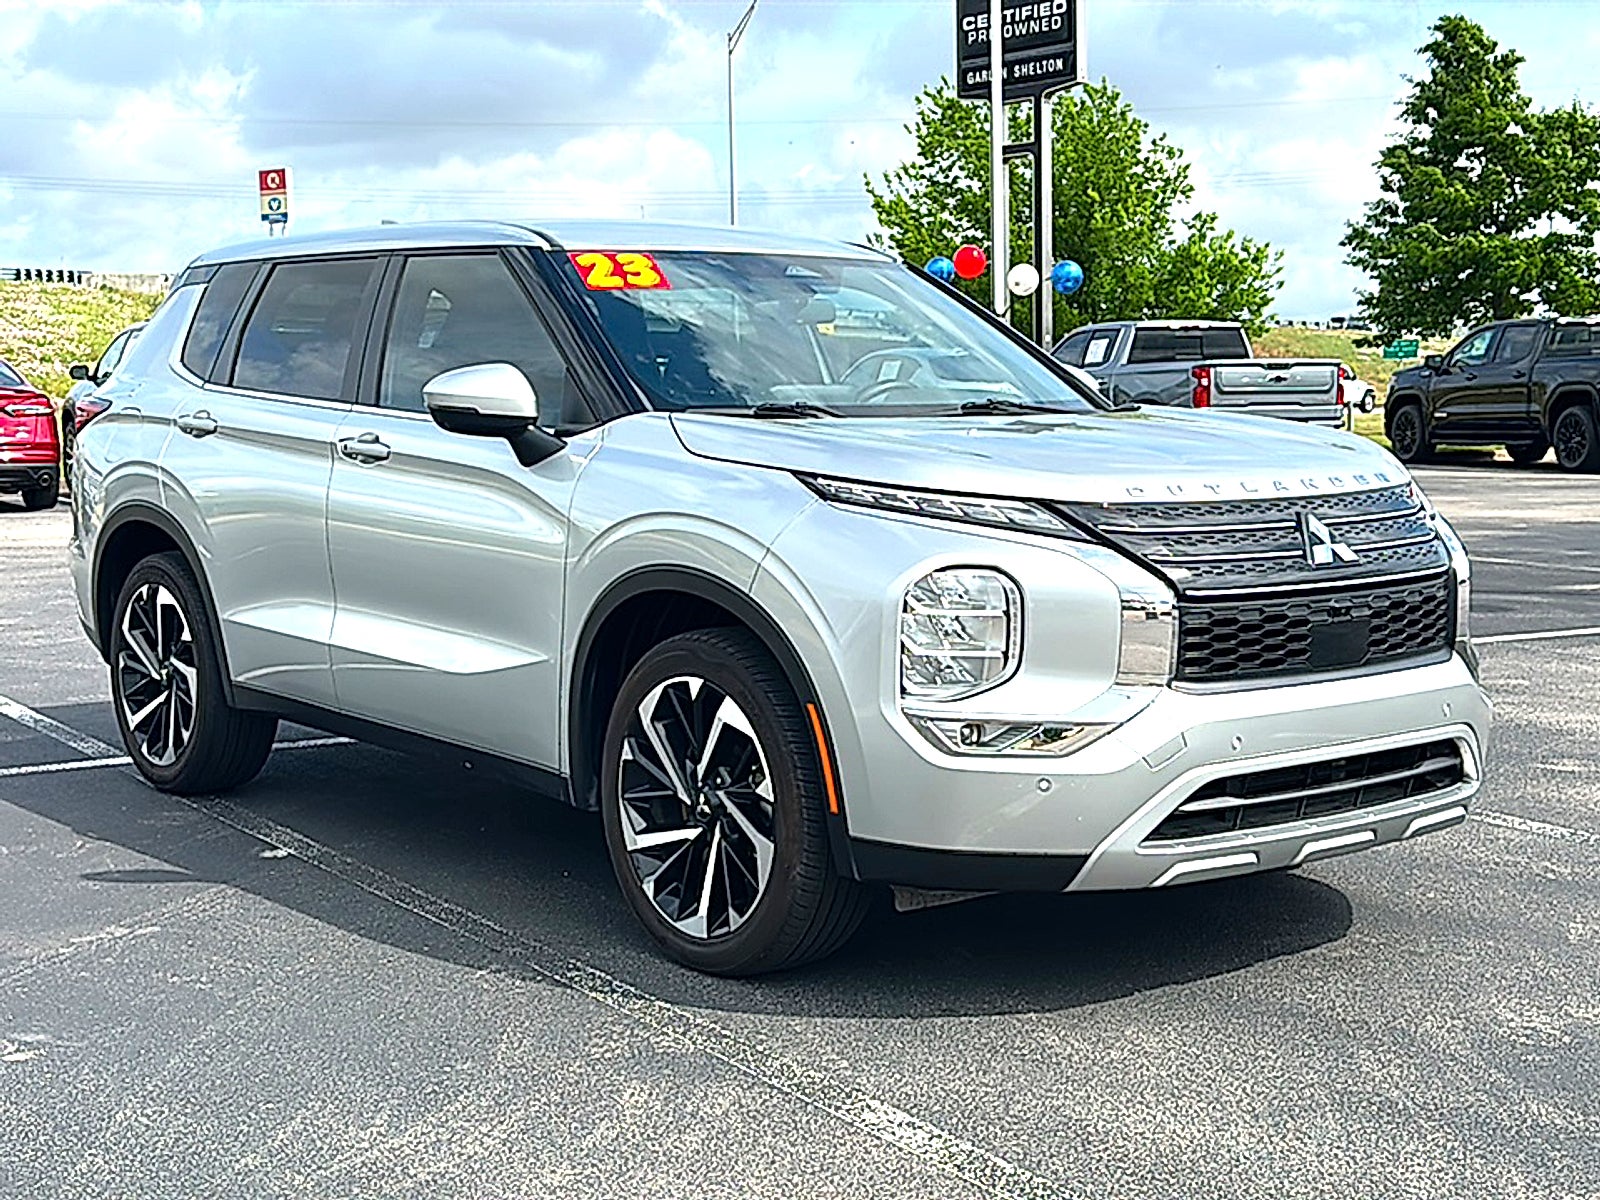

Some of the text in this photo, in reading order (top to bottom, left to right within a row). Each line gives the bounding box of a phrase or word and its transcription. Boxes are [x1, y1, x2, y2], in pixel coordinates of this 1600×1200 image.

[962, 0, 1067, 31] CETIFIED
[966, 58, 1063, 85] GARLN SHELTON
[575, 252, 661, 287] 23
